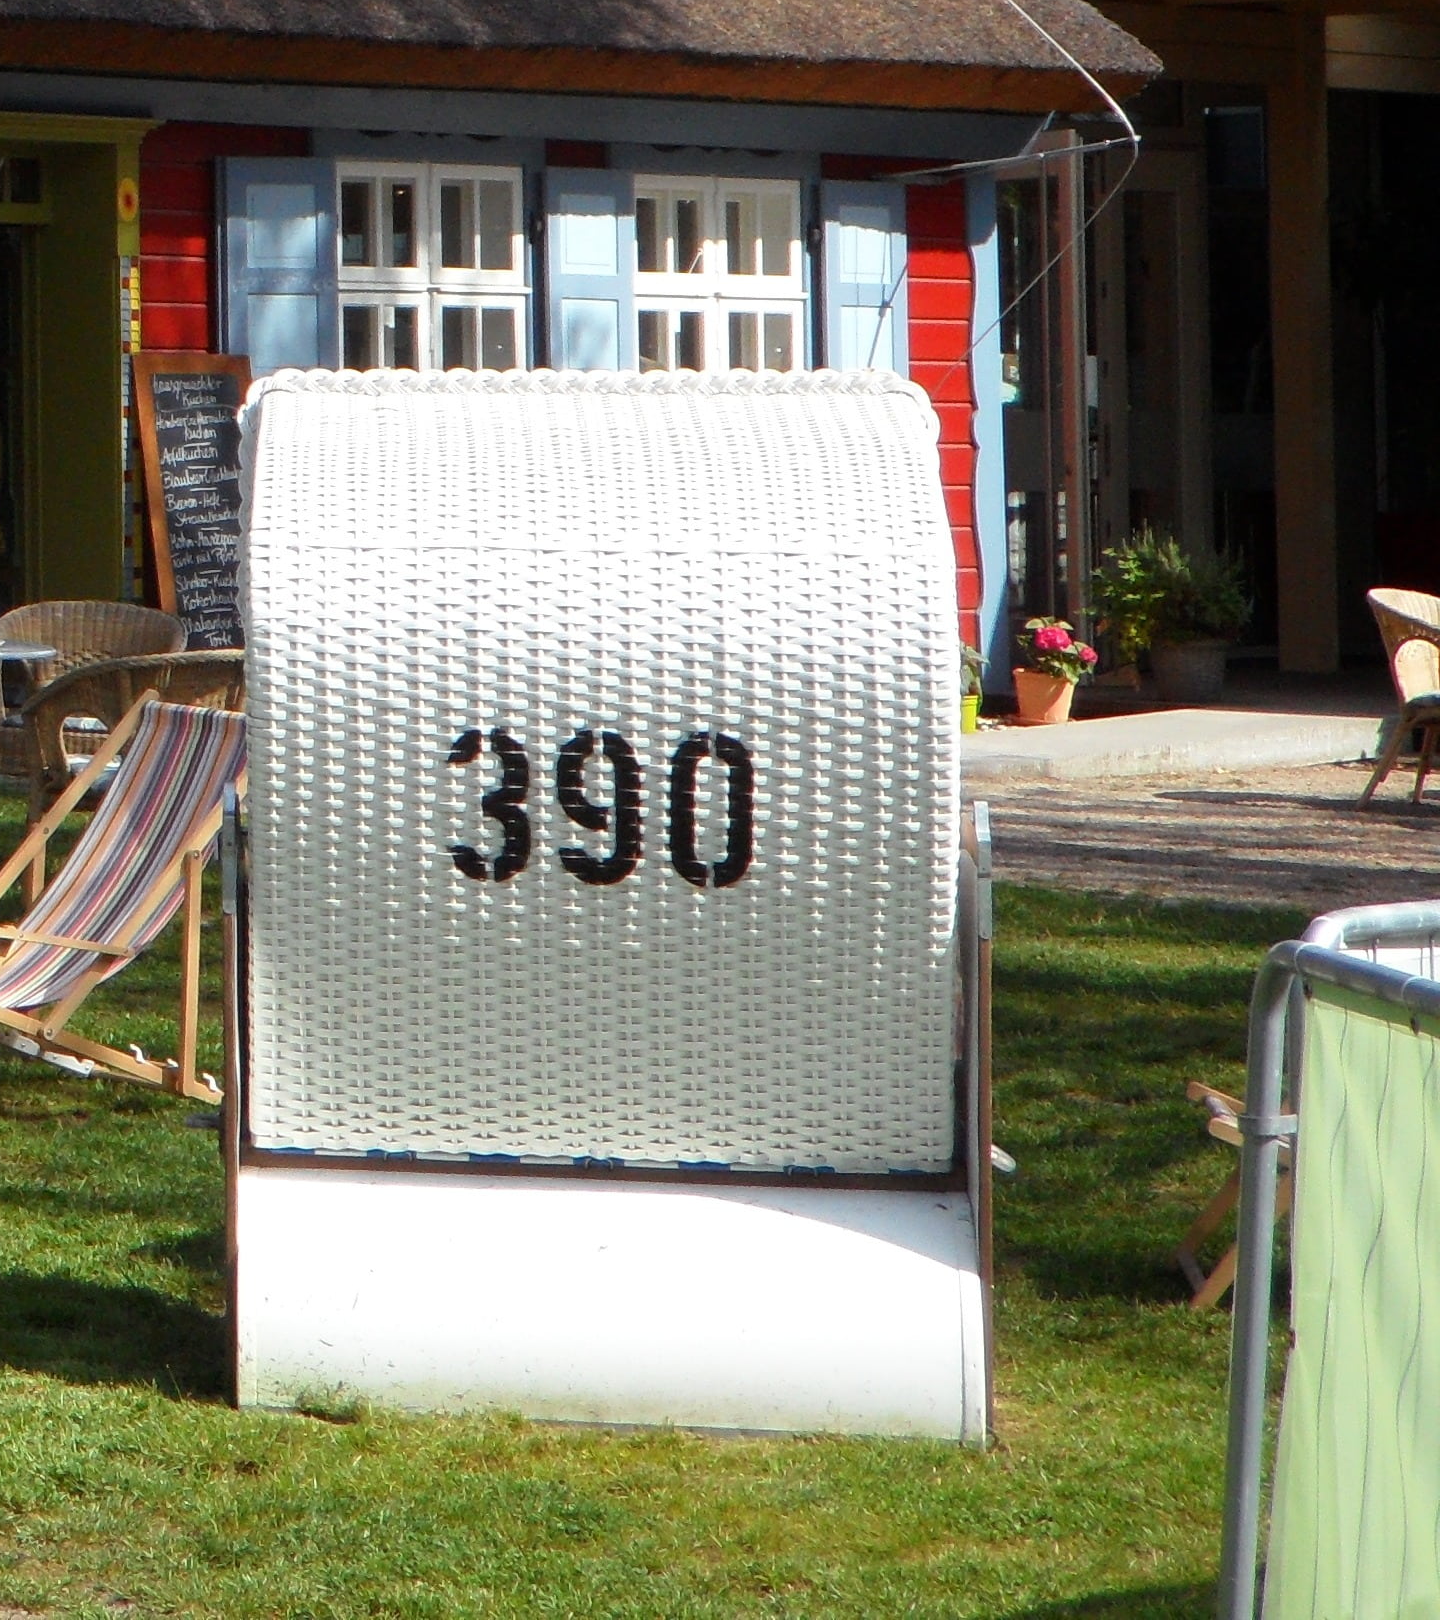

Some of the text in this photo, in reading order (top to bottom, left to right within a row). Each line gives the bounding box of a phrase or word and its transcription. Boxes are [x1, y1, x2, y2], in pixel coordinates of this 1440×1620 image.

[182, 389, 217, 408] Kuchen
[204, 631, 234, 648] Torte
[447, 727, 756, 888] 390
